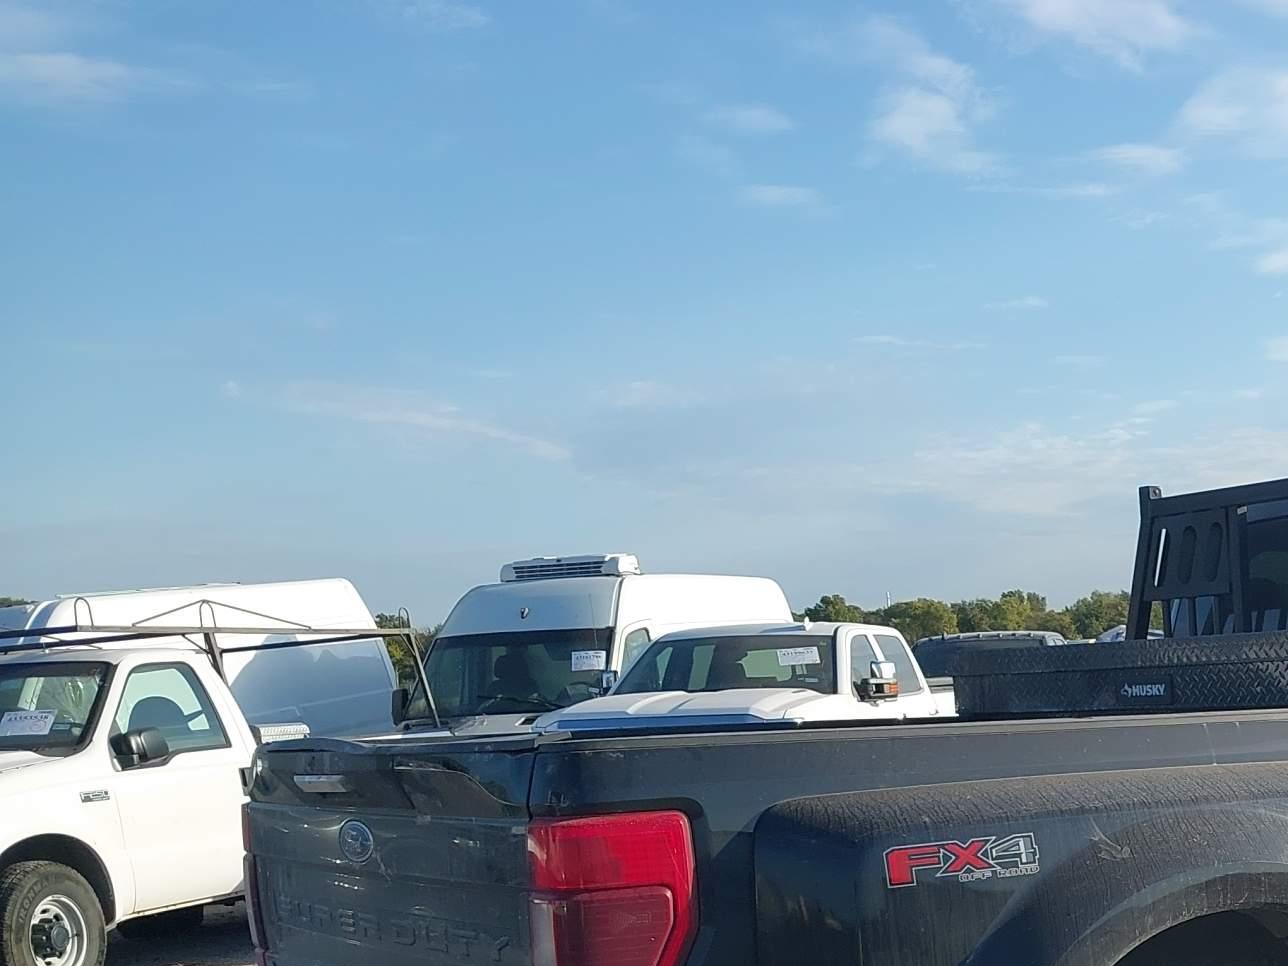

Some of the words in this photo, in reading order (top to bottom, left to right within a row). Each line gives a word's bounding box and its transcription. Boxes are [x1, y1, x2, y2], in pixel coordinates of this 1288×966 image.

[1131, 683, 1166, 698] HUSKY
[883, 832, 1040, 888] FX4
[959, 871, 992, 883] OFF
[997, 865, 1041, 879] ROAD
[278, 897, 384, 942] SUPER
[392, 917, 512, 962] DUTY
